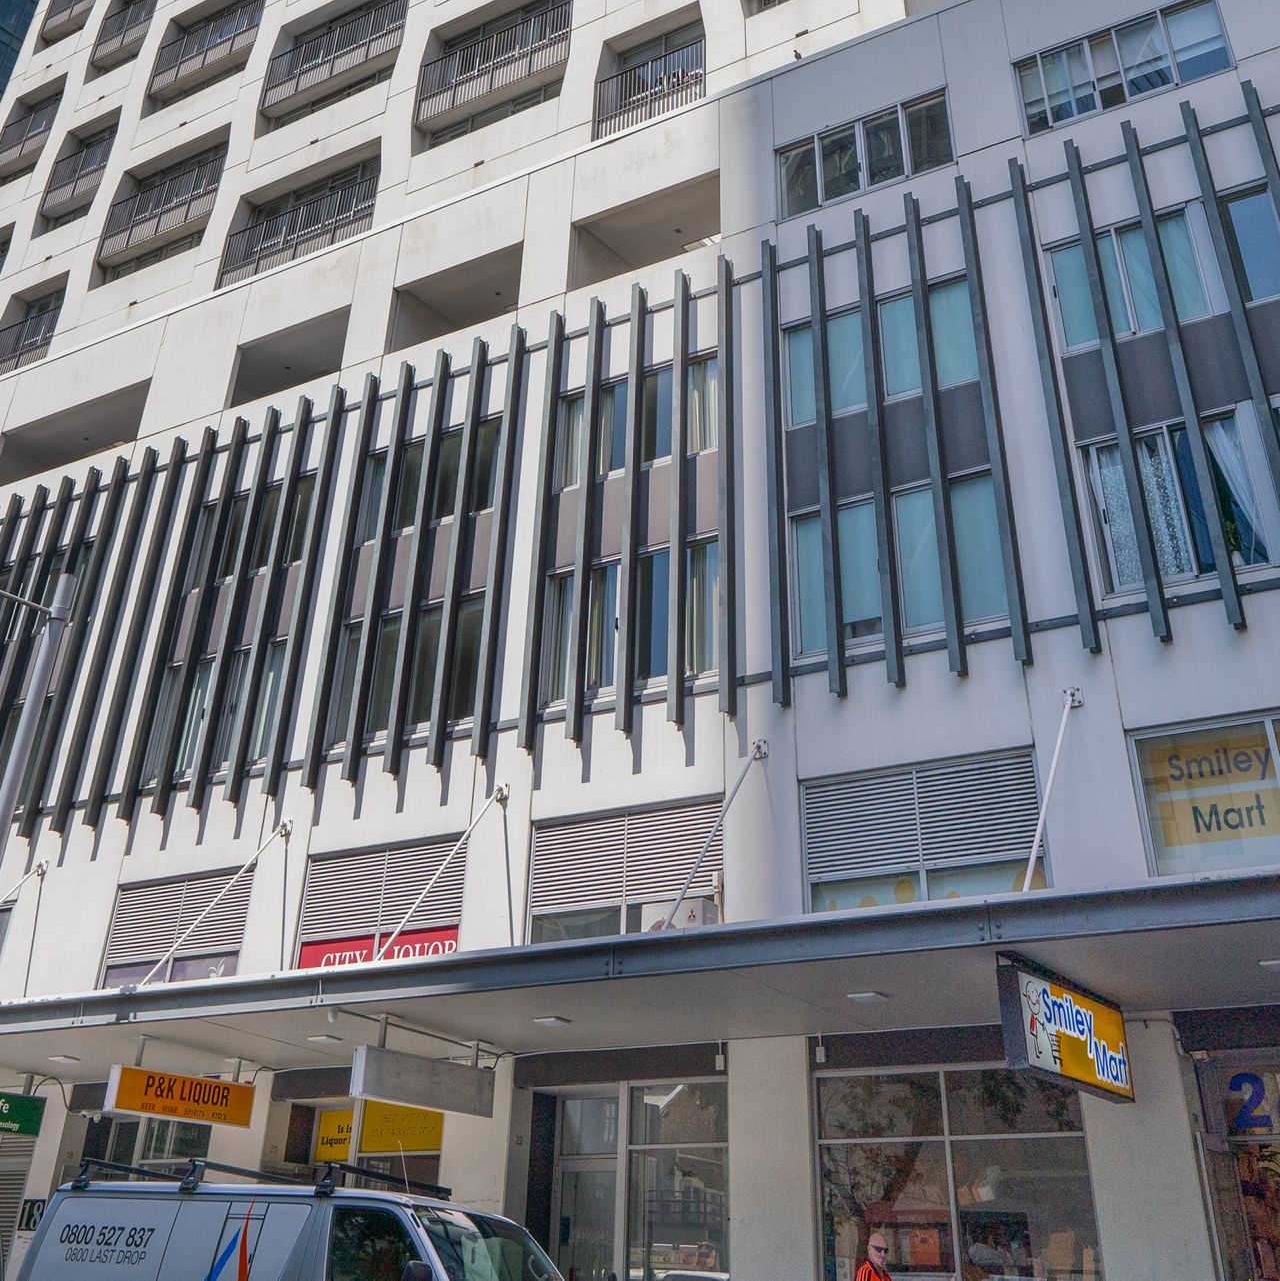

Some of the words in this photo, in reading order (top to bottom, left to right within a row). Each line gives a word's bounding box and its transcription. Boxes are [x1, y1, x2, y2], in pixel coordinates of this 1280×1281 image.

[1167, 746, 1271, 781] Smiley
[1191, 793, 1266, 833] Mart
[321, 949, 368, 967] CITY
[380, 940, 457, 961] IQUOR
[1042, 987, 1094, 1055] Smiley
[1094, 1040, 1129, 1086] Mart
[144, 1075, 177, 1100] P&K
[179, 1080, 230, 1107] LIQUOR
[162, 1105, 178, 1114] WINE
[184, 1108, 205, 1118] SPIRITS
[320, 1136, 347, 1146] Liquor
[19, 1202, 43, 1230] 18
[60, 1224, 96, 1245] 0800
[96, 1226, 126, 1246] 527
[125, 1227, 156, 1248] 837
[65, 1247, 89, 1262] 0800
[89, 1249, 116, 1264] LAST
[116, 1250, 147, 1265] DROP
